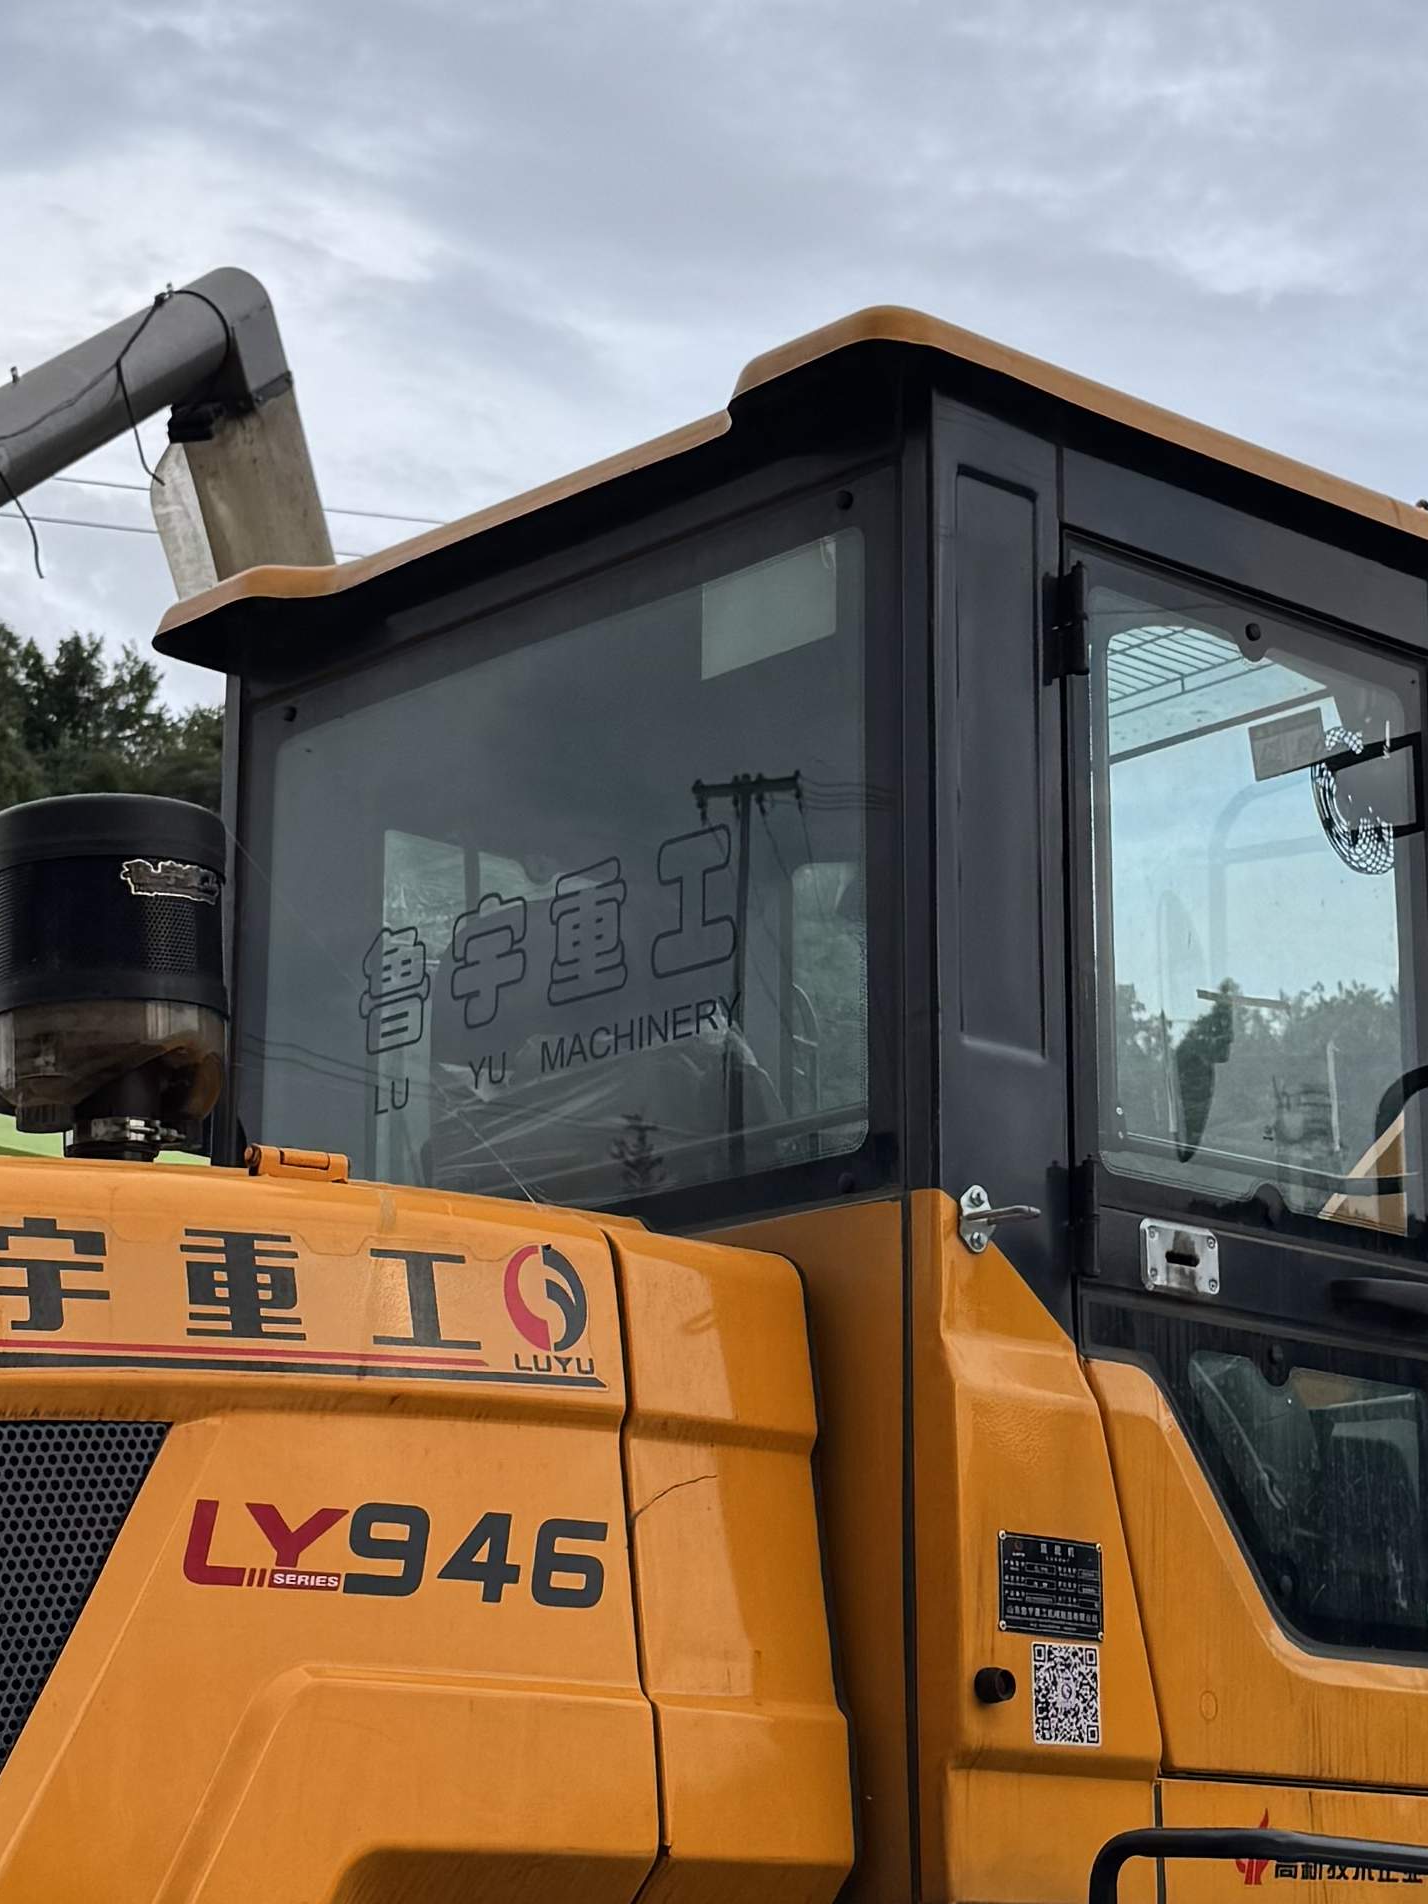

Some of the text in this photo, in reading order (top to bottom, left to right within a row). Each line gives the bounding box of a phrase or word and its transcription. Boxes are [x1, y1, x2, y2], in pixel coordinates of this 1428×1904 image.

[359, 823, 738, 1055] 鲁宇重工
[375, 992, 740, 1116] LU YU MACHINERY
[513, 1353, 594, 1376] LUYU
[183, 1499, 608, 1608] LY946
[272, 1572, 340, 1588] SERIES
